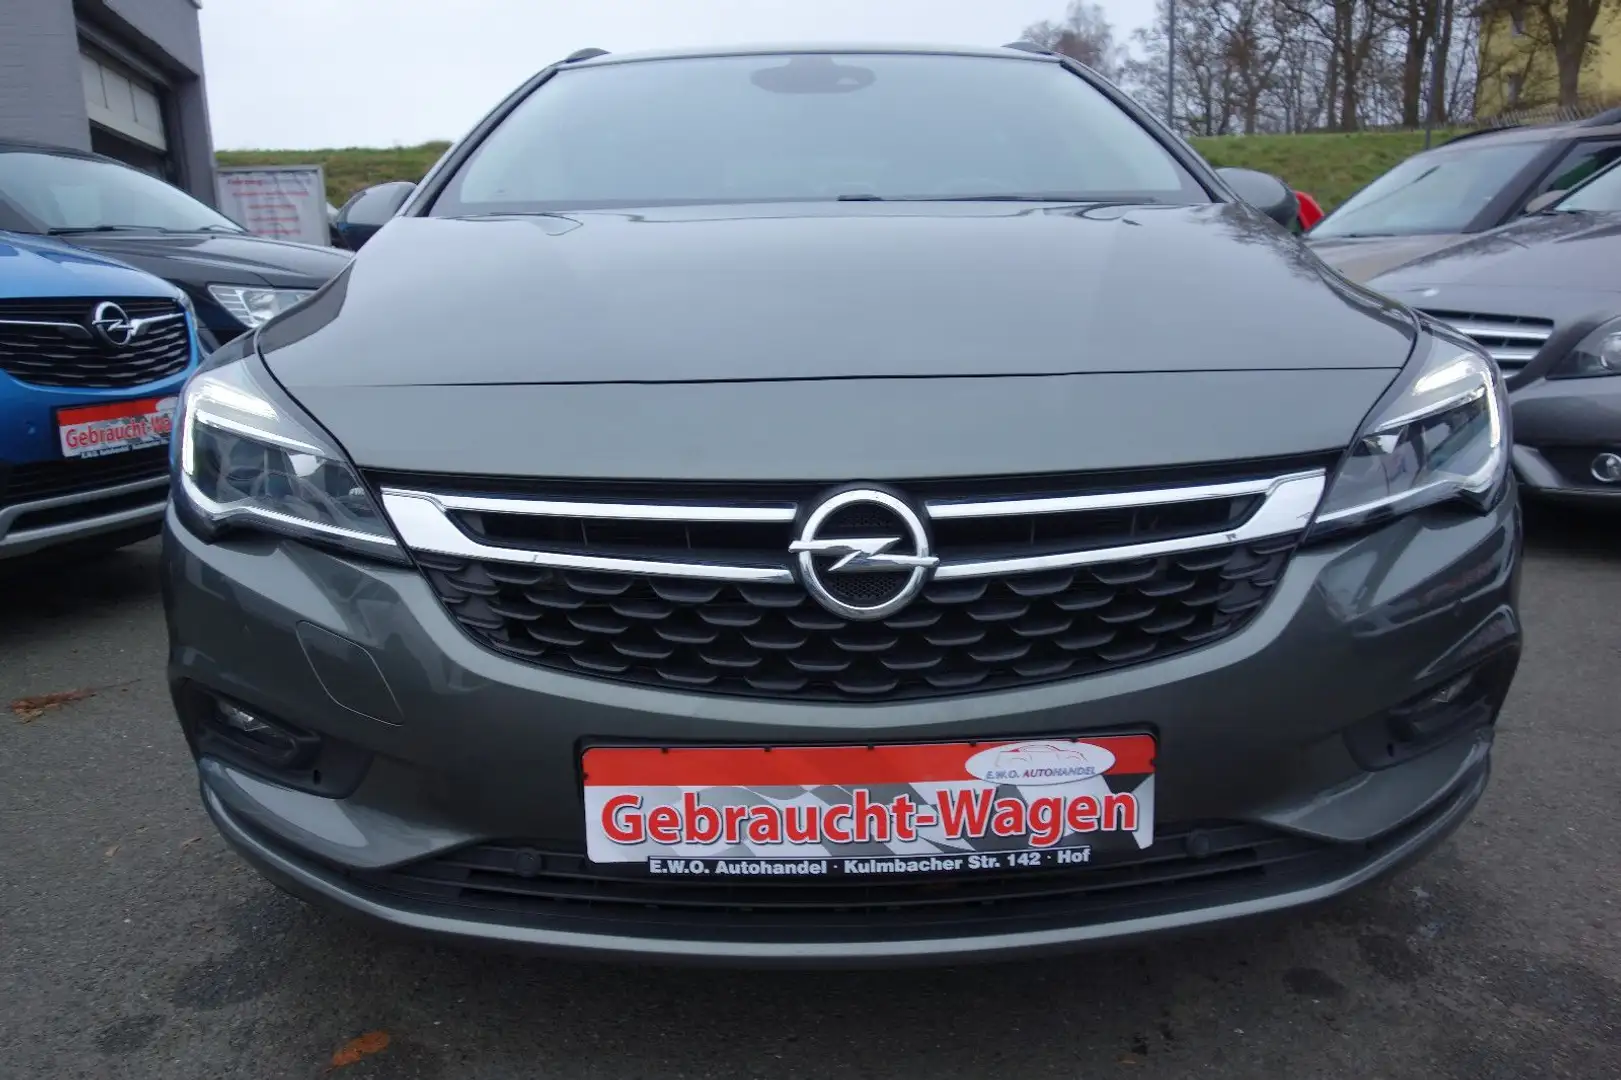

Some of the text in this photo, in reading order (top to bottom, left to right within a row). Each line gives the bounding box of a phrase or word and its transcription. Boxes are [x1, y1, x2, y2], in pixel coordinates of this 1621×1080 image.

[986, 766, 1097, 780] E.W.O. AUTOHANDEL
[600, 787, 1140, 848] Gebraucht-Wagen
[649, 848, 1090, 875] E.W.O. Autohandel Kulmbacher Str. 142 Hof
